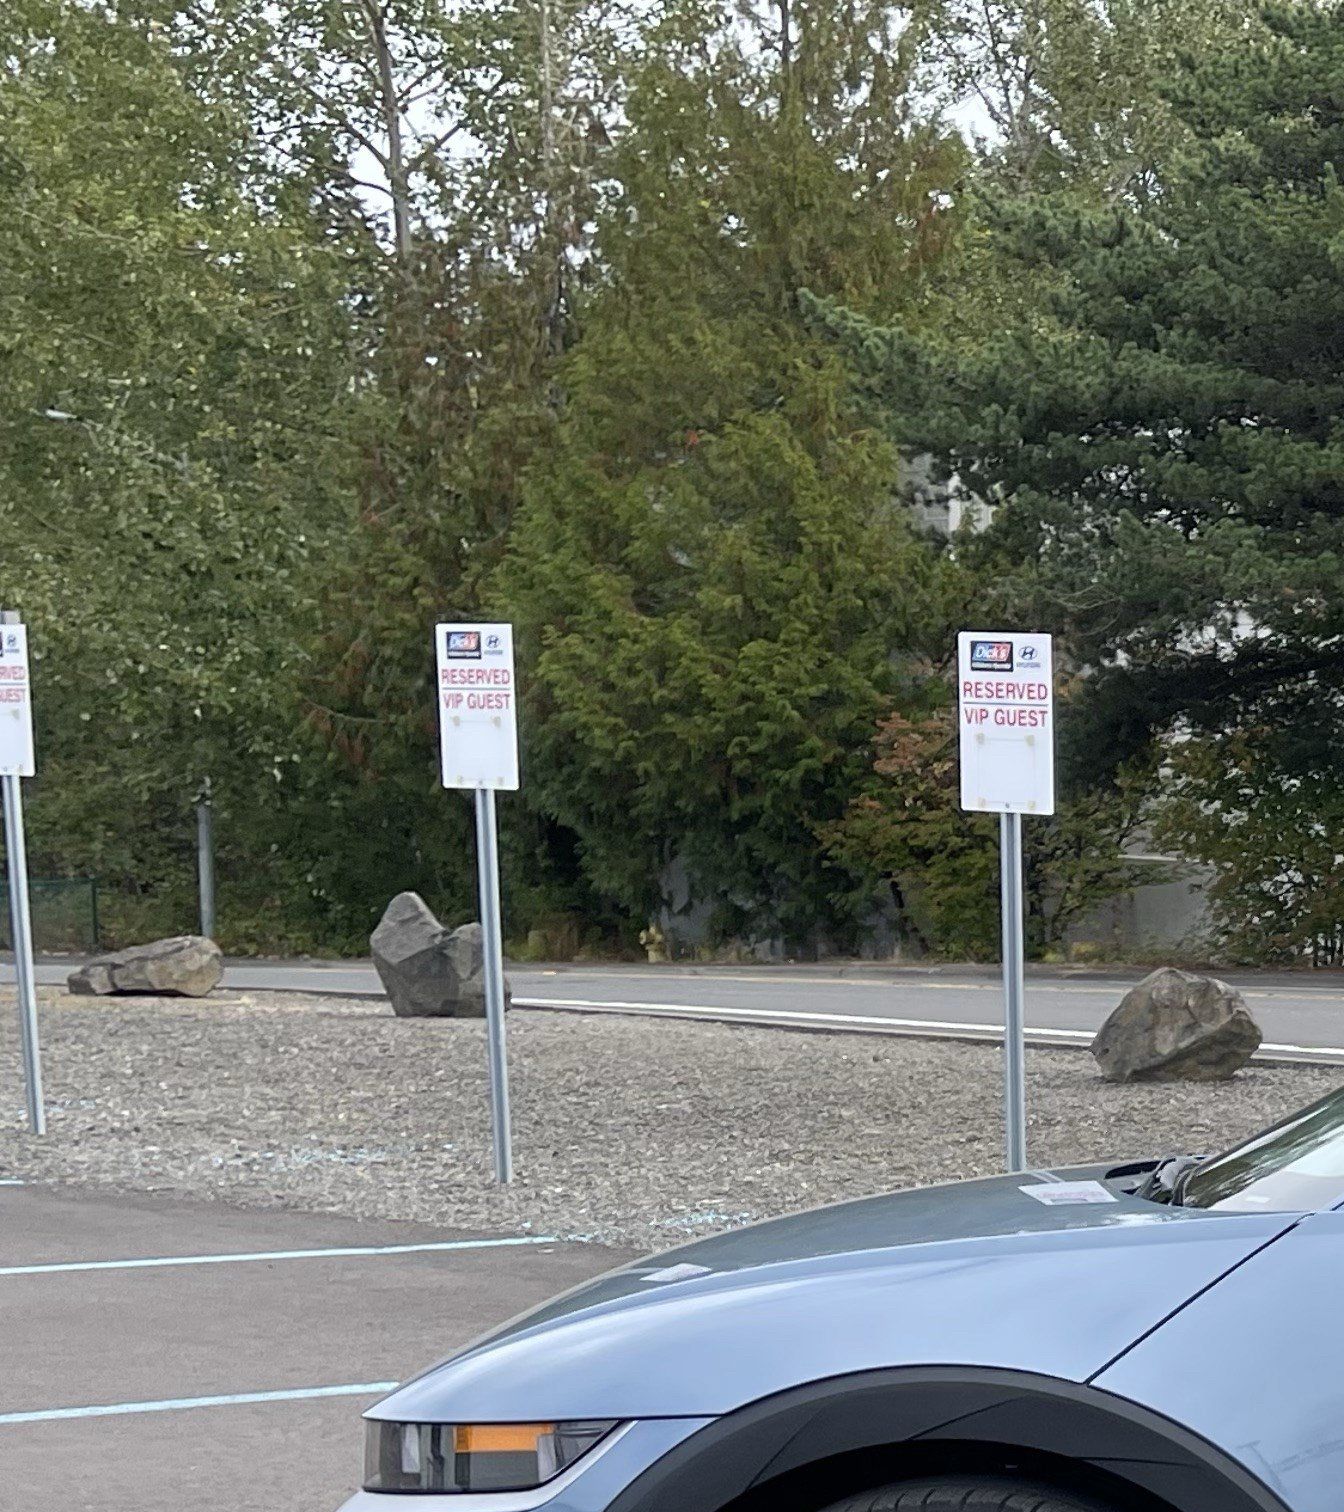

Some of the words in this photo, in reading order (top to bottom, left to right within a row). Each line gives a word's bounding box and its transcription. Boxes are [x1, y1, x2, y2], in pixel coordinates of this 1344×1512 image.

[441, 668, 511, 685] RESERVED
[963, 681, 1048, 701] RESERVED
[443, 693, 463, 709] VIP
[467, 693, 511, 709] GUEST
[964, 708, 988, 725] VIP
[994, 709, 1048, 727] GUEST
